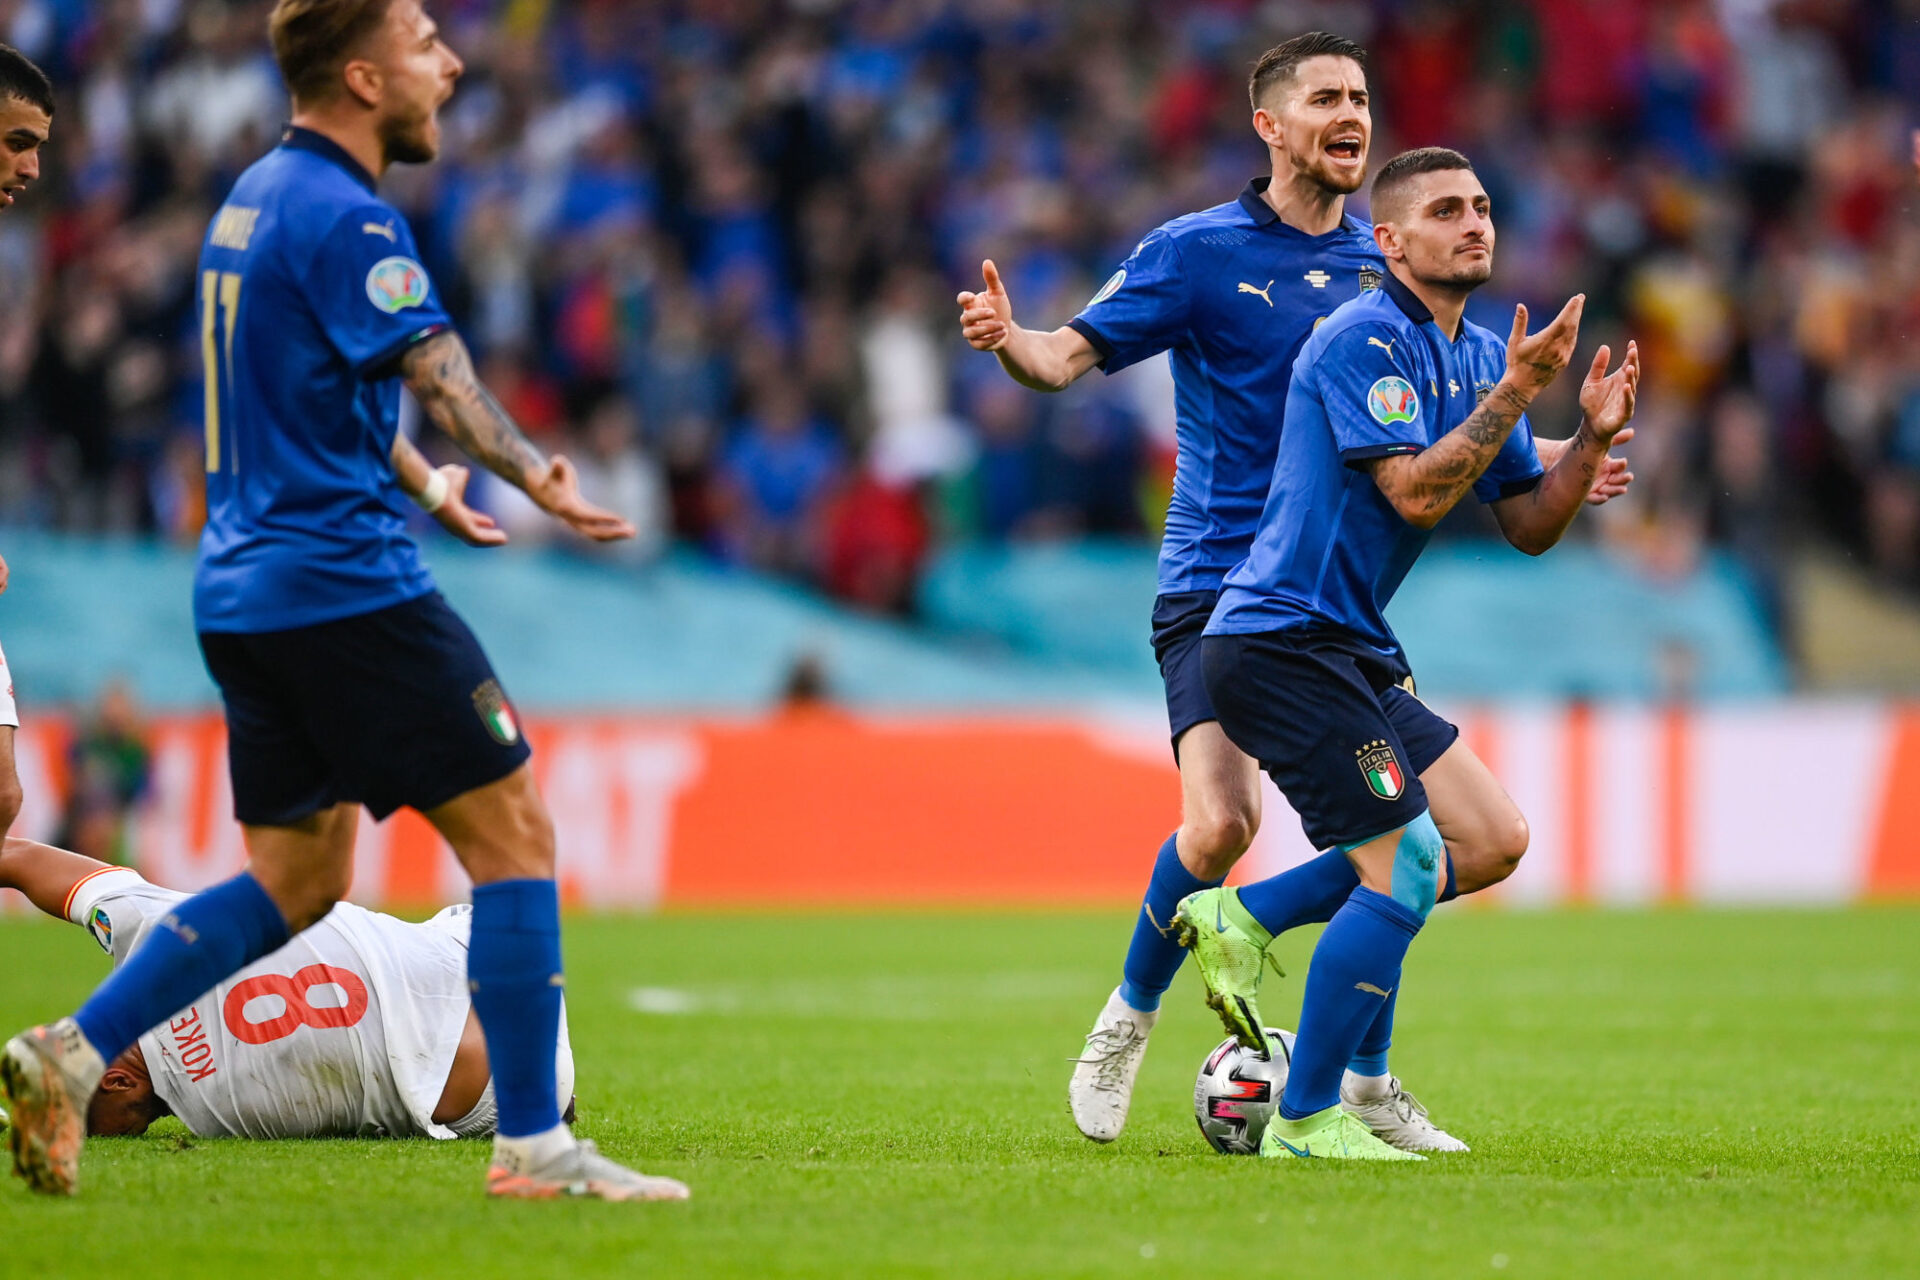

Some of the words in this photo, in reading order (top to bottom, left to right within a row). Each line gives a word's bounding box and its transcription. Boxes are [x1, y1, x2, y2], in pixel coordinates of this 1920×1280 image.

[1362, 750, 1391, 769] ITALIA
[223, 963, 368, 1045] 8
[170, 1006, 217, 1083] KOKE
